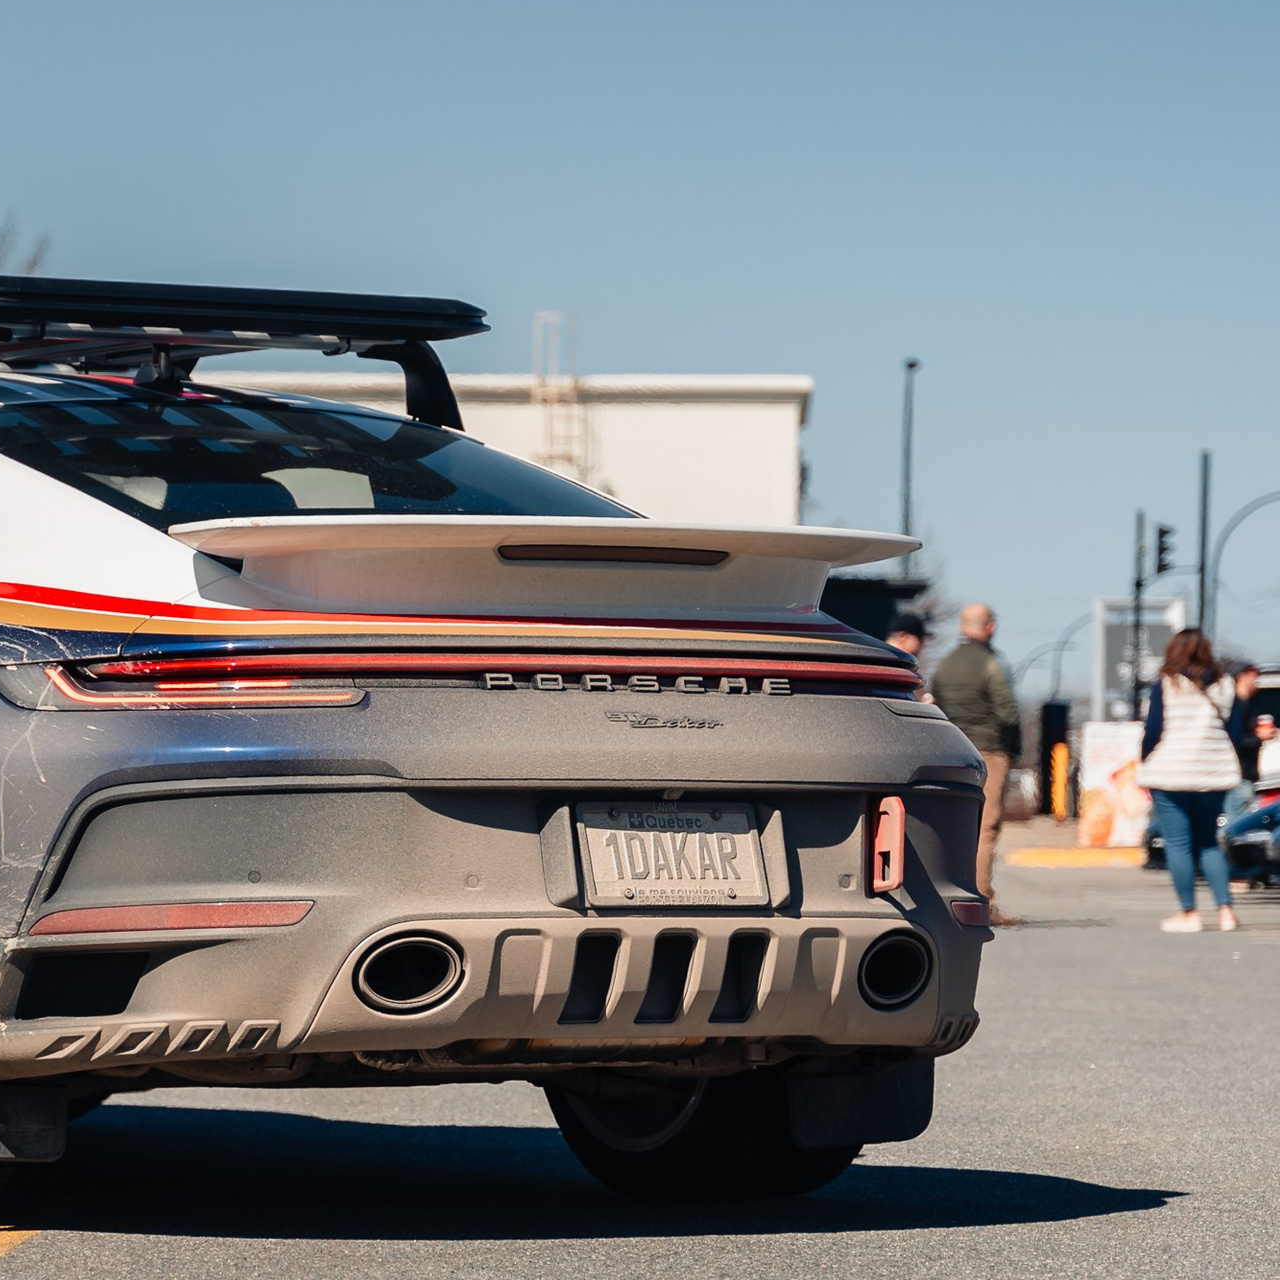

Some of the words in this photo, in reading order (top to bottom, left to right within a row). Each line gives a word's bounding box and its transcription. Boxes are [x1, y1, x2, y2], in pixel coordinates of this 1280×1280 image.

[482, 673, 792, 695] PORSCHE
[652, 803, 679, 812] LAVAL
[645, 813, 703, 829] Québec
[605, 832, 741, 880] 1DAKAR
